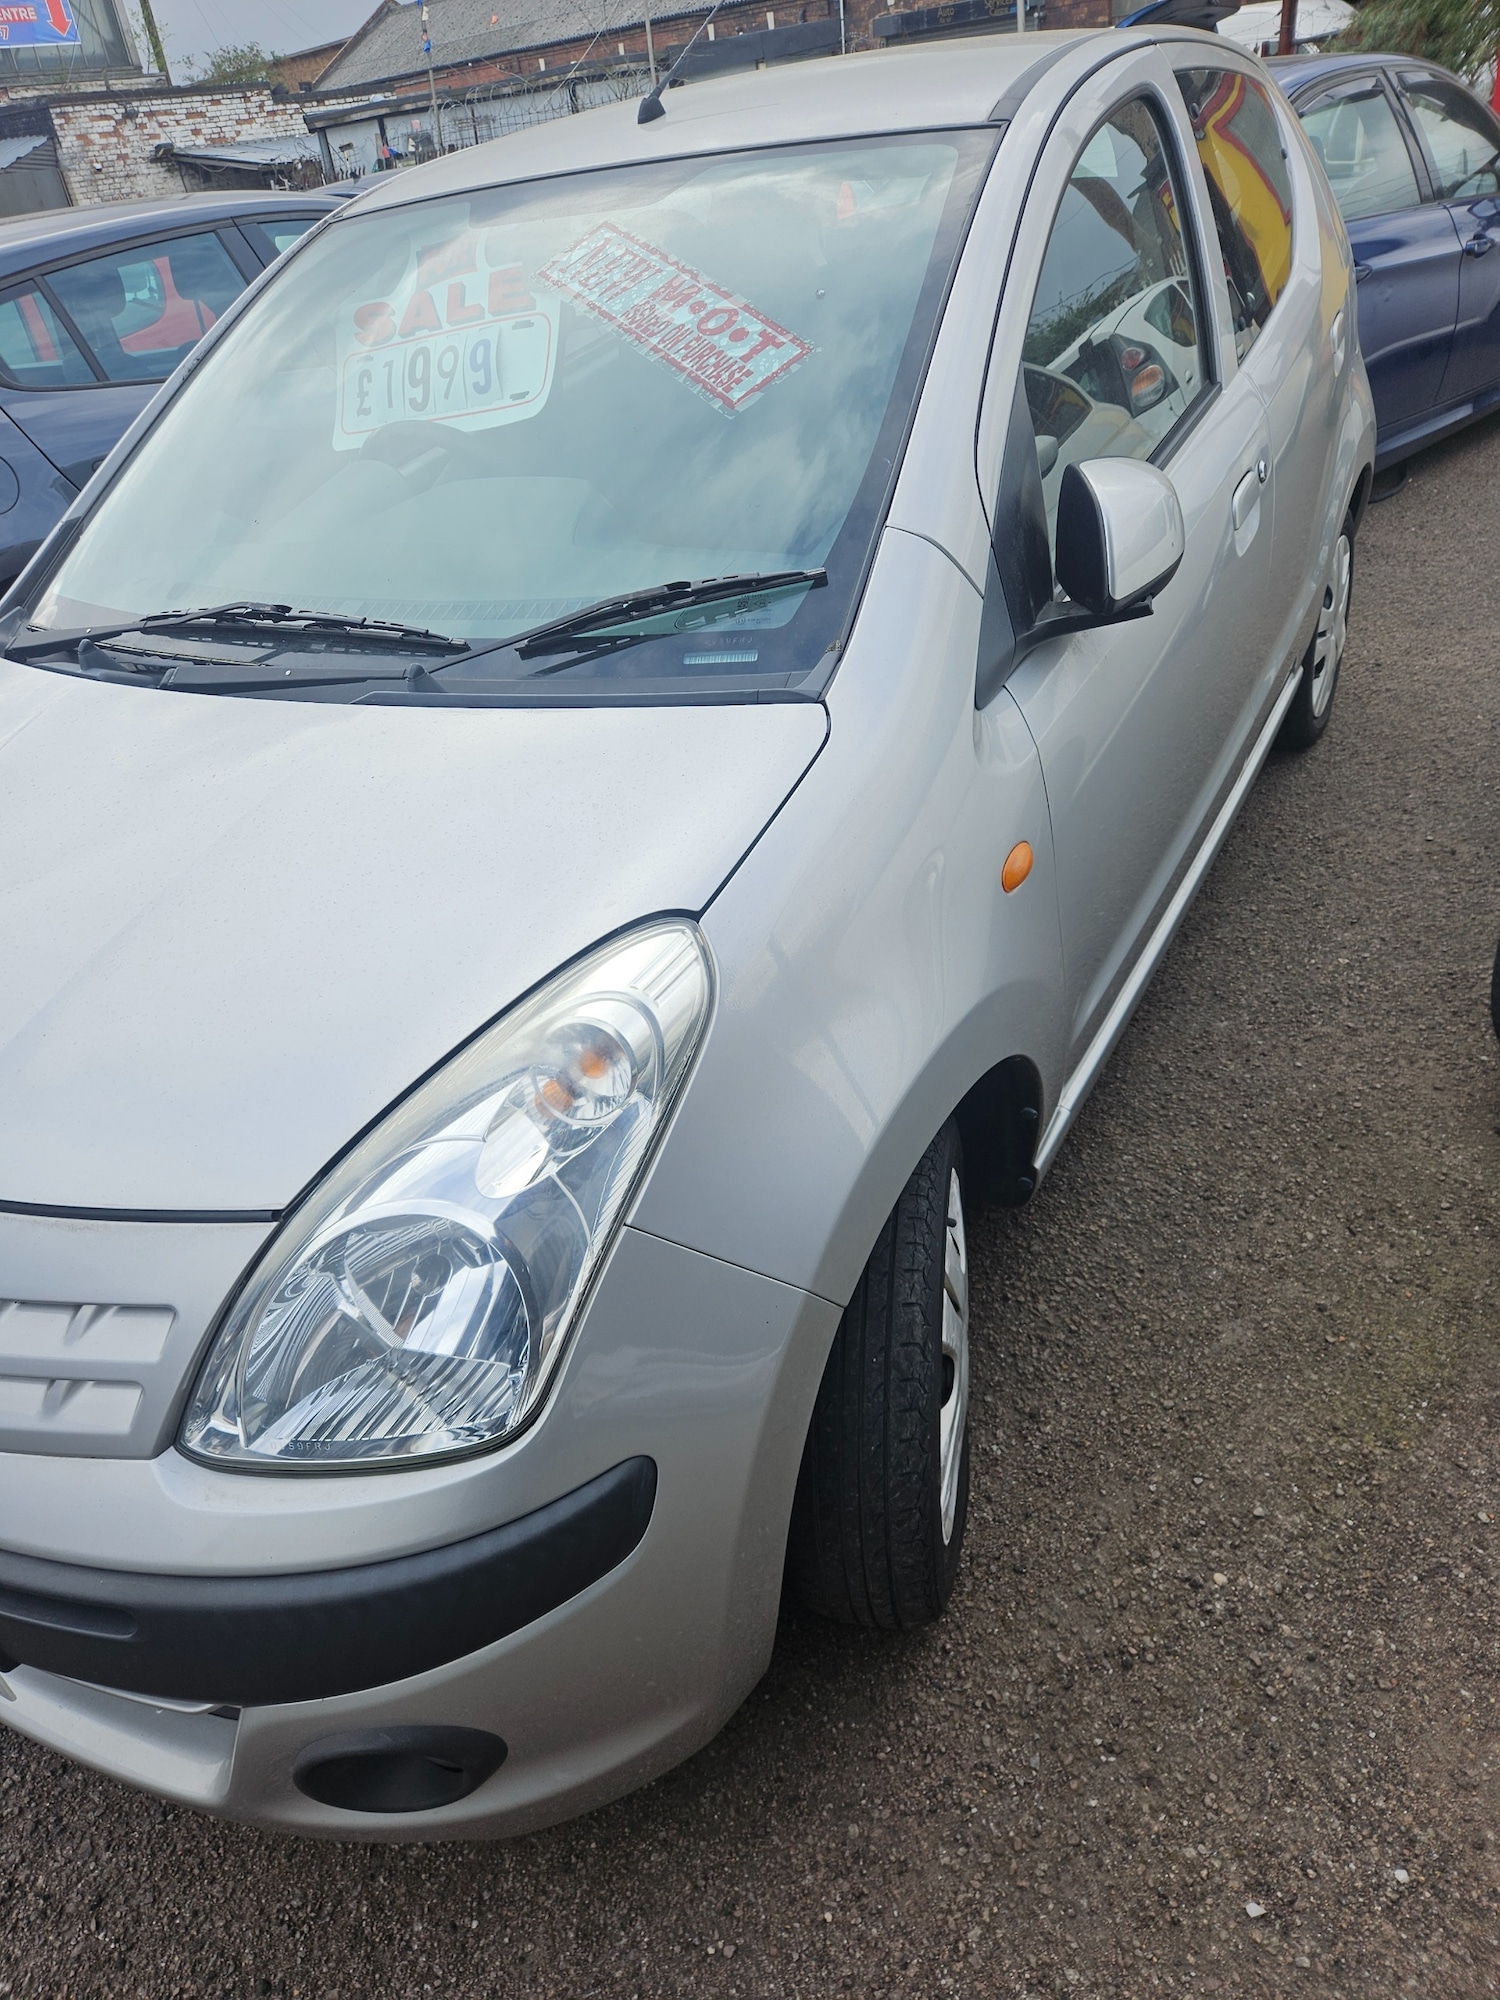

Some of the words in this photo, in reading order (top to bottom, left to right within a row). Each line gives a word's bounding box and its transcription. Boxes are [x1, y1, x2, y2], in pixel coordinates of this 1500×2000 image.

[557, 237, 663, 303] NEW
[353, 265, 536, 347] SALE
[619, 298, 673, 337] ISSUED
[657, 323, 694, 353] ON
[673, 334, 755, 394] PURCHASE
[356, 338, 492, 418] £1999
